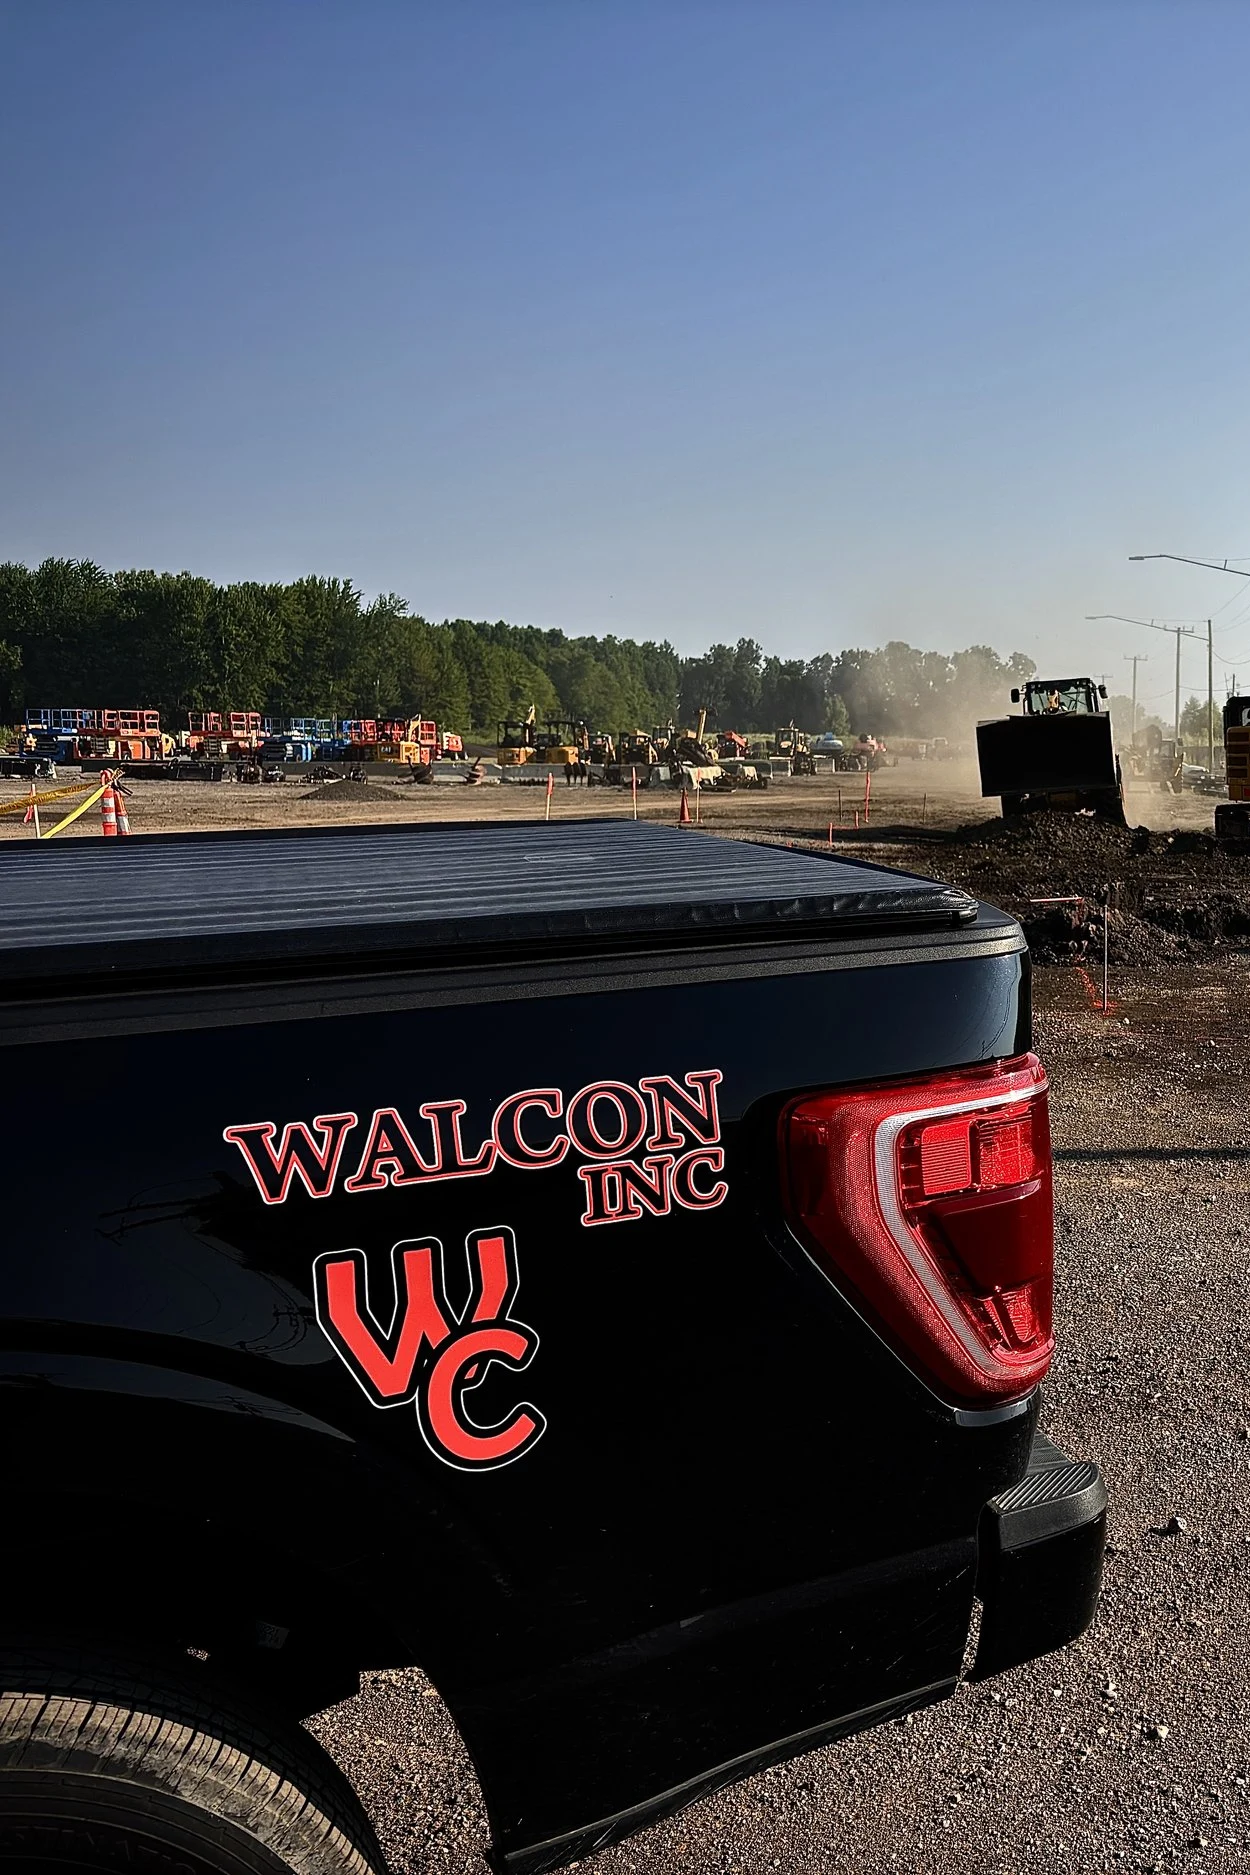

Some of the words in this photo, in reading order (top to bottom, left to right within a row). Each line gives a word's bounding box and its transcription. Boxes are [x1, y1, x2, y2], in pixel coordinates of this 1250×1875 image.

[223, 1069, 723, 1204] WALCON
[577, 1147, 728, 1227] INC
[314, 1225, 547, 1471] WC
